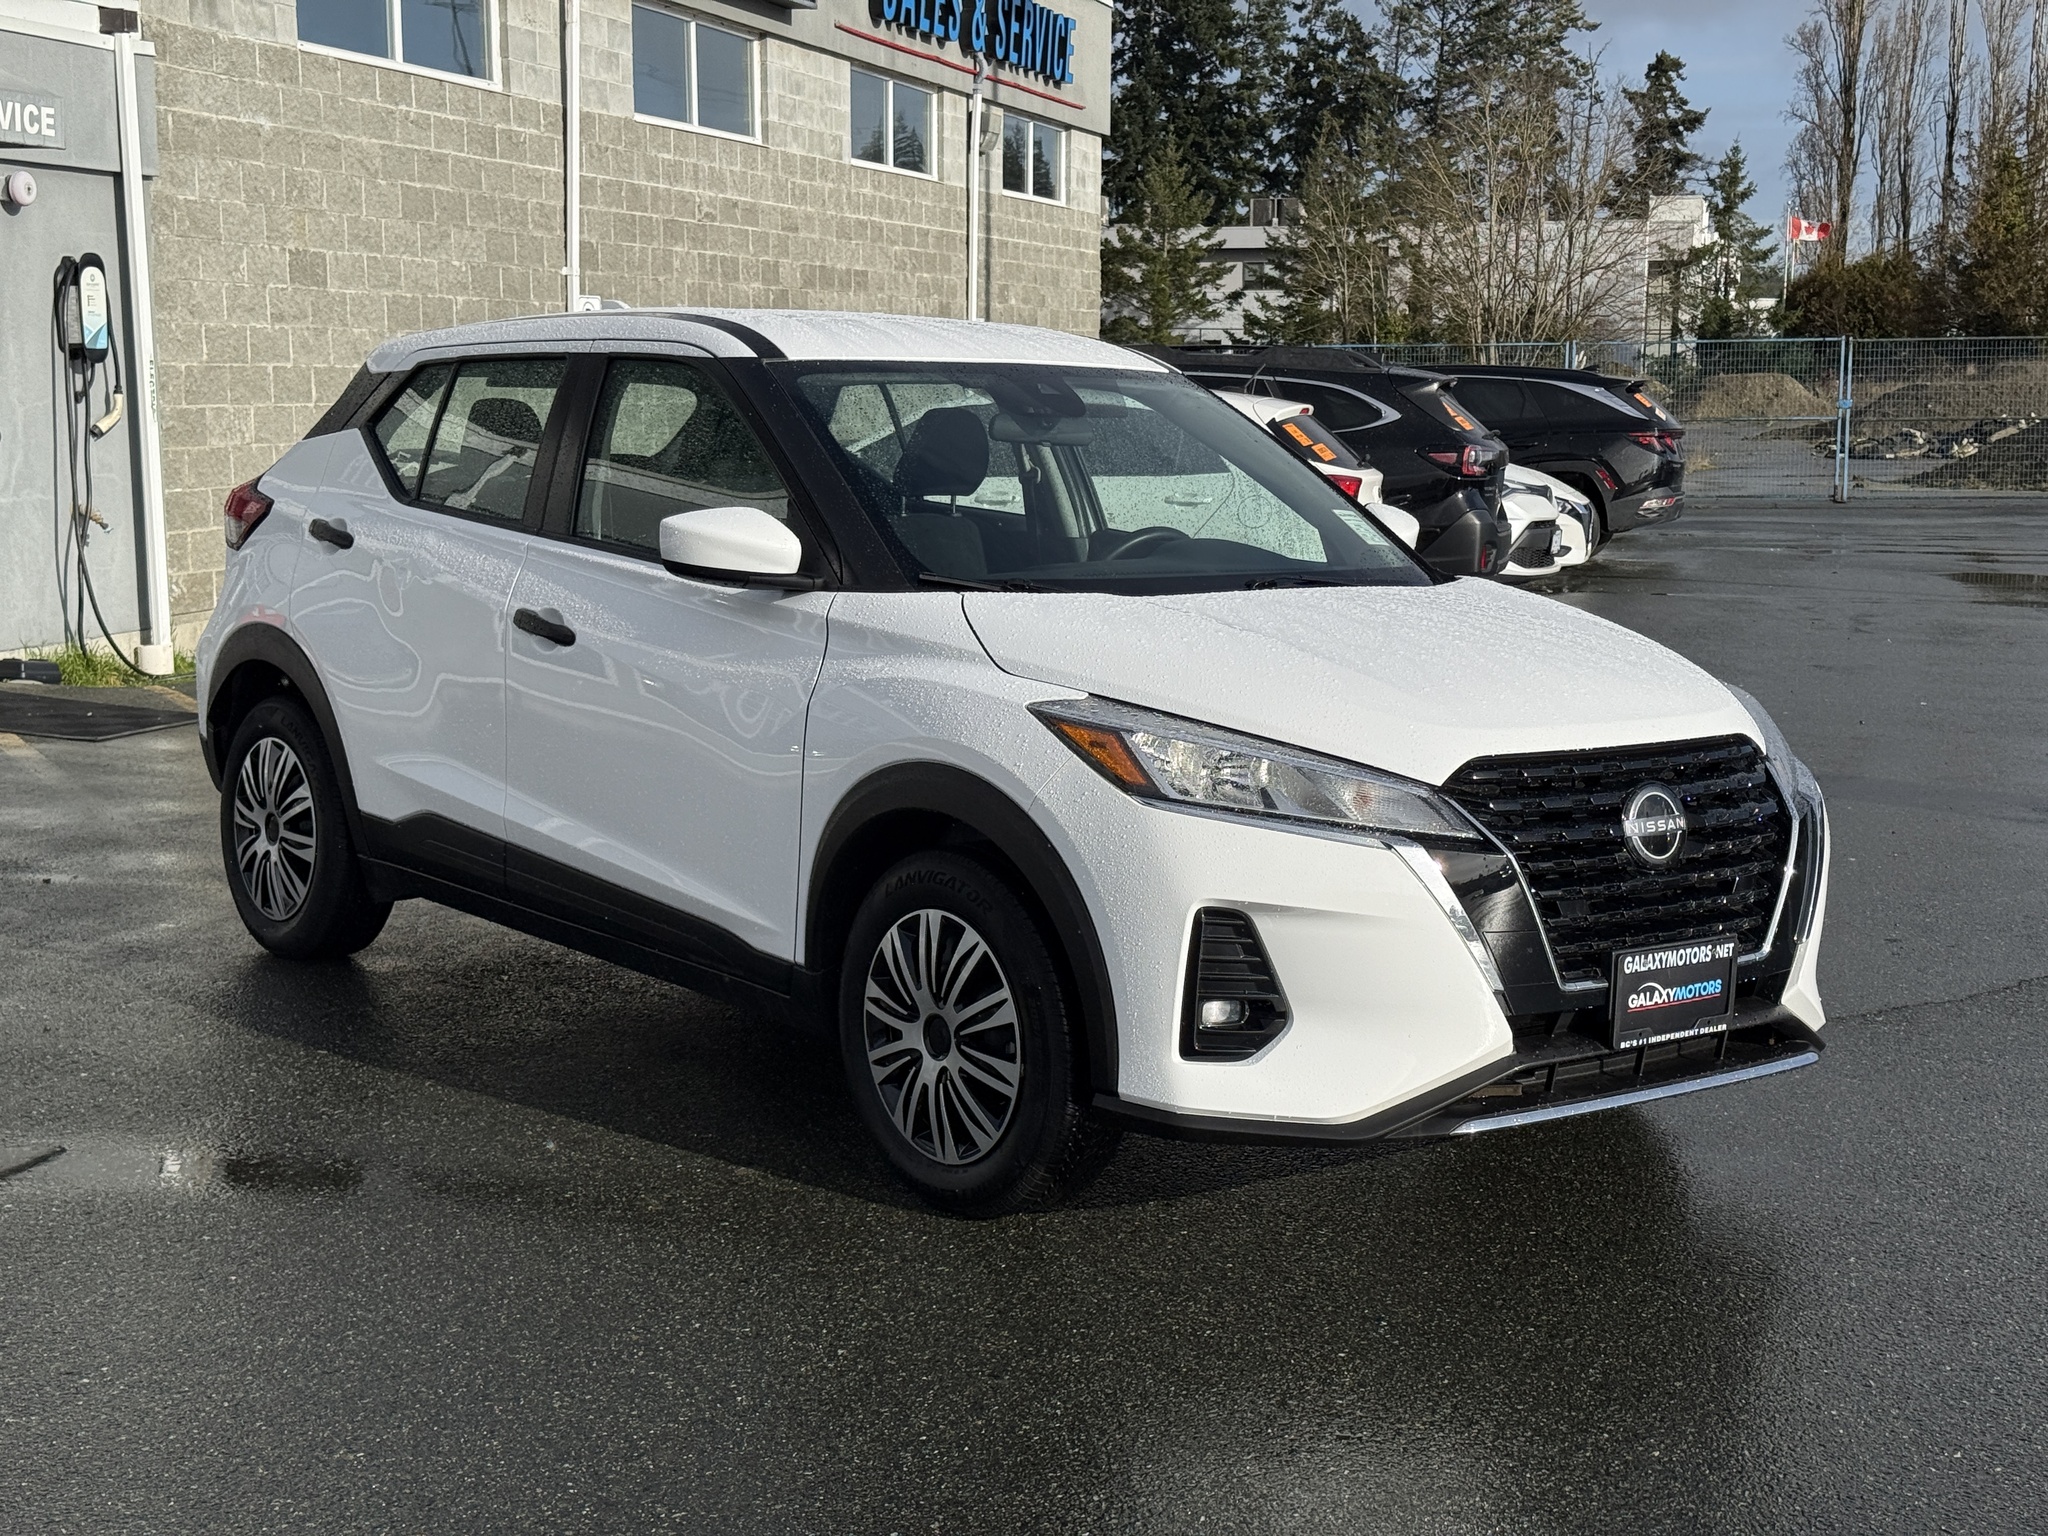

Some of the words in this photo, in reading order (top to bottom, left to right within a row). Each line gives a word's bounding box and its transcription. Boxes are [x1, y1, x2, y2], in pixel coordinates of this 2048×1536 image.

[882, 0, 961, 42] LES
[995, 0, 1076, 84] SERVICE
[1628, 816, 1684, 834] NISSAN
[885, 869, 993, 915] LANVIGATOR
[1624, 942, 1735, 975] GALAXYMOTORSNET
[1628, 979, 1722, 1009] GALAXYMOTORS
[1620, 1041, 1638, 1049] BC'S
[1638, 1038, 1647, 1046] #1
[1648, 1028, 1699, 1044] INDEPENDENT
[1699, 1023, 1728, 1035] DEALER
